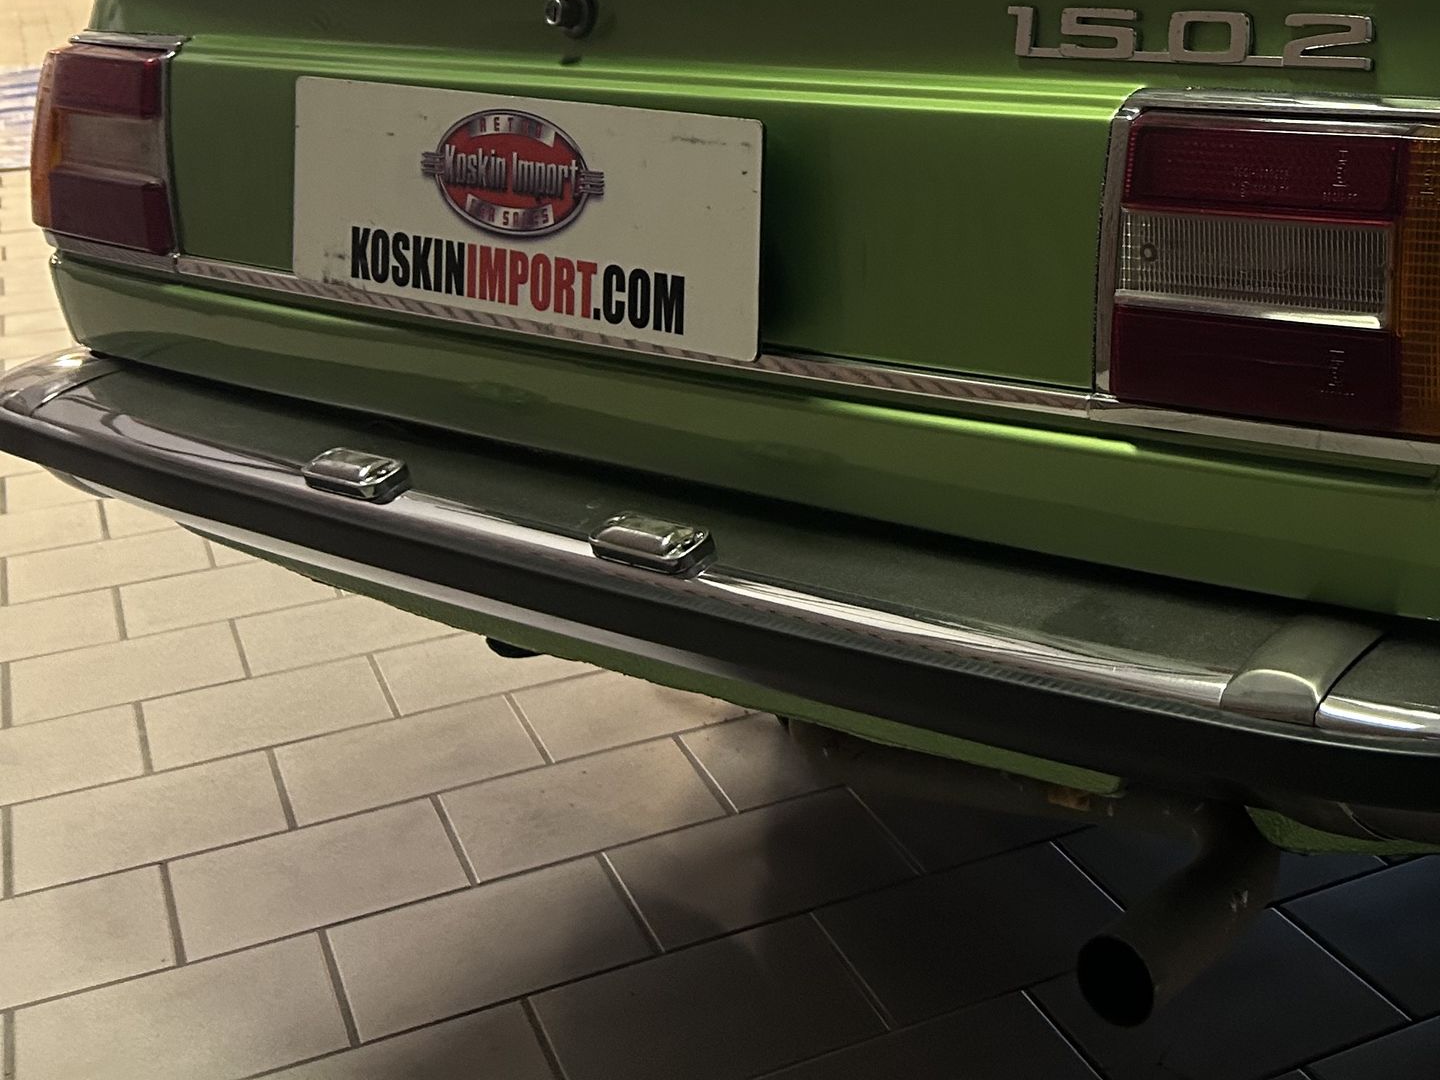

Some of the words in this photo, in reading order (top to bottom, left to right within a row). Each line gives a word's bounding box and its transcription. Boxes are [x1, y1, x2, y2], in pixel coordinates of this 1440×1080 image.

[1007, 5, 1373, 71] 1502
[444, 143, 507, 191] Koskin
[511, 151, 579, 199] Import
[350, 225, 686, 336] KOSKINIMPORT.COM
